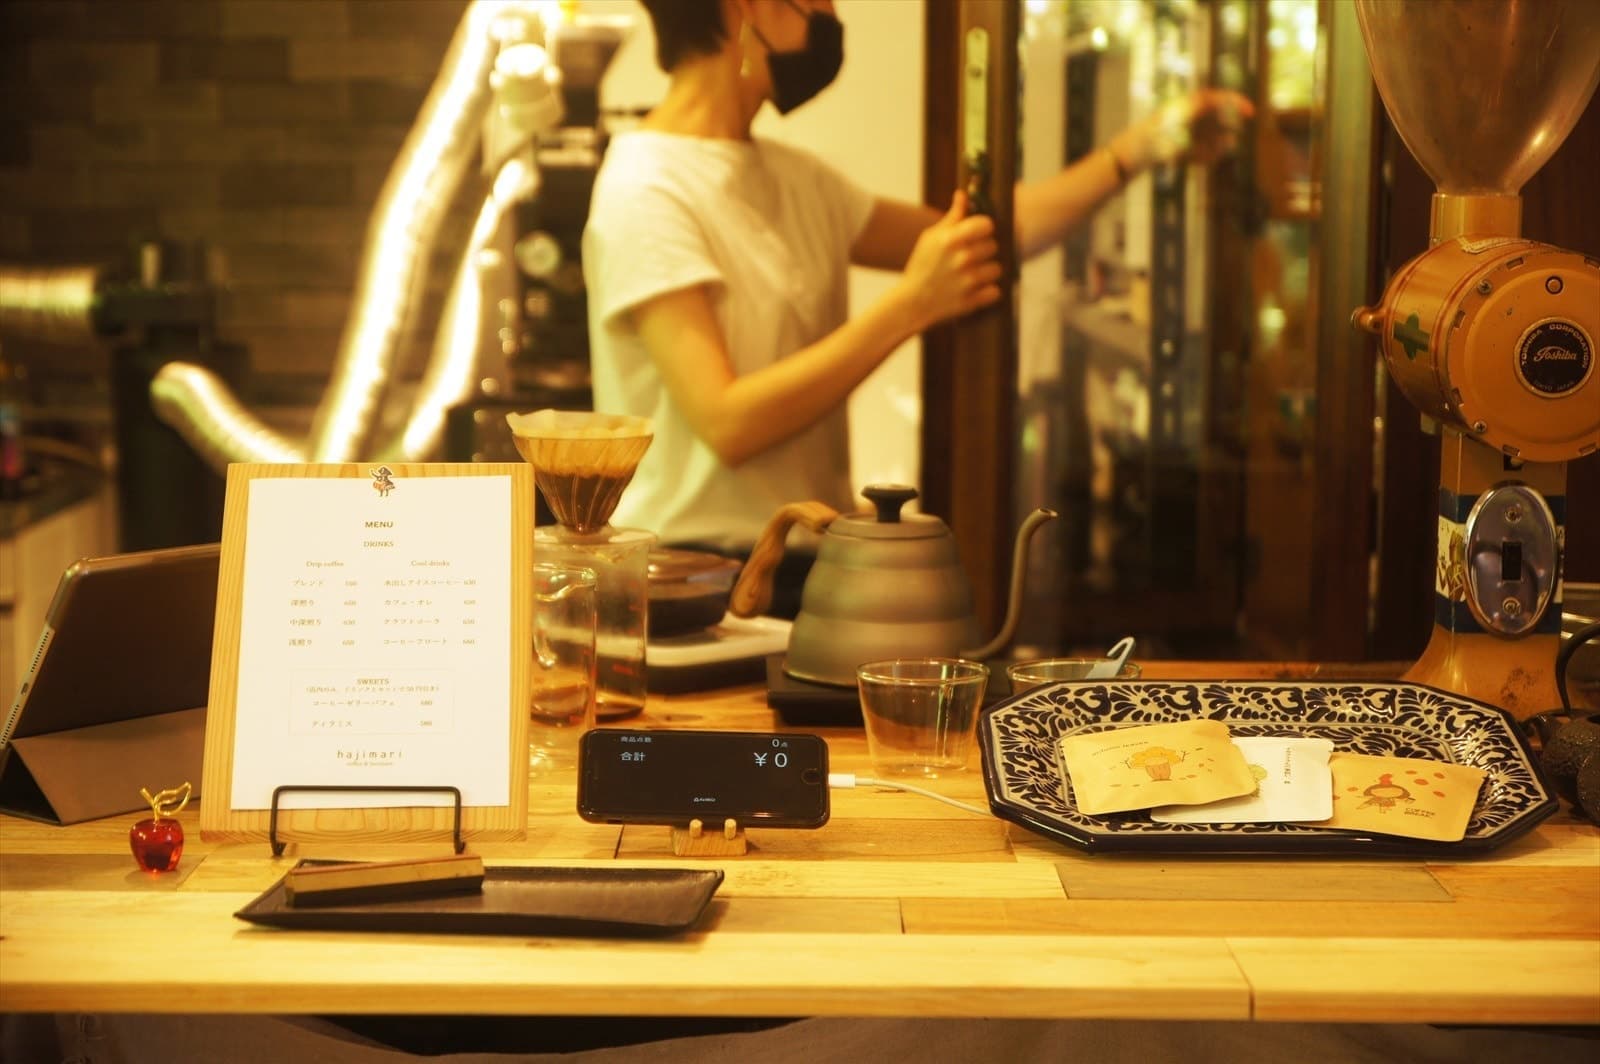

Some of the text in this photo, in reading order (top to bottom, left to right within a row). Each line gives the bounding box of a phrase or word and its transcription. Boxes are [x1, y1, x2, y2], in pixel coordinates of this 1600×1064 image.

[1533, 346, 1577, 362] Toshiba
[364, 519, 394, 529] MENU
[363, 540, 394, 549] DRINKS
[305, 560, 345, 569] Drip coffee
[428, 559, 451, 568] drinks
[337, 750, 402, 760] hajimari
[619, 751, 646, 762] 合計
